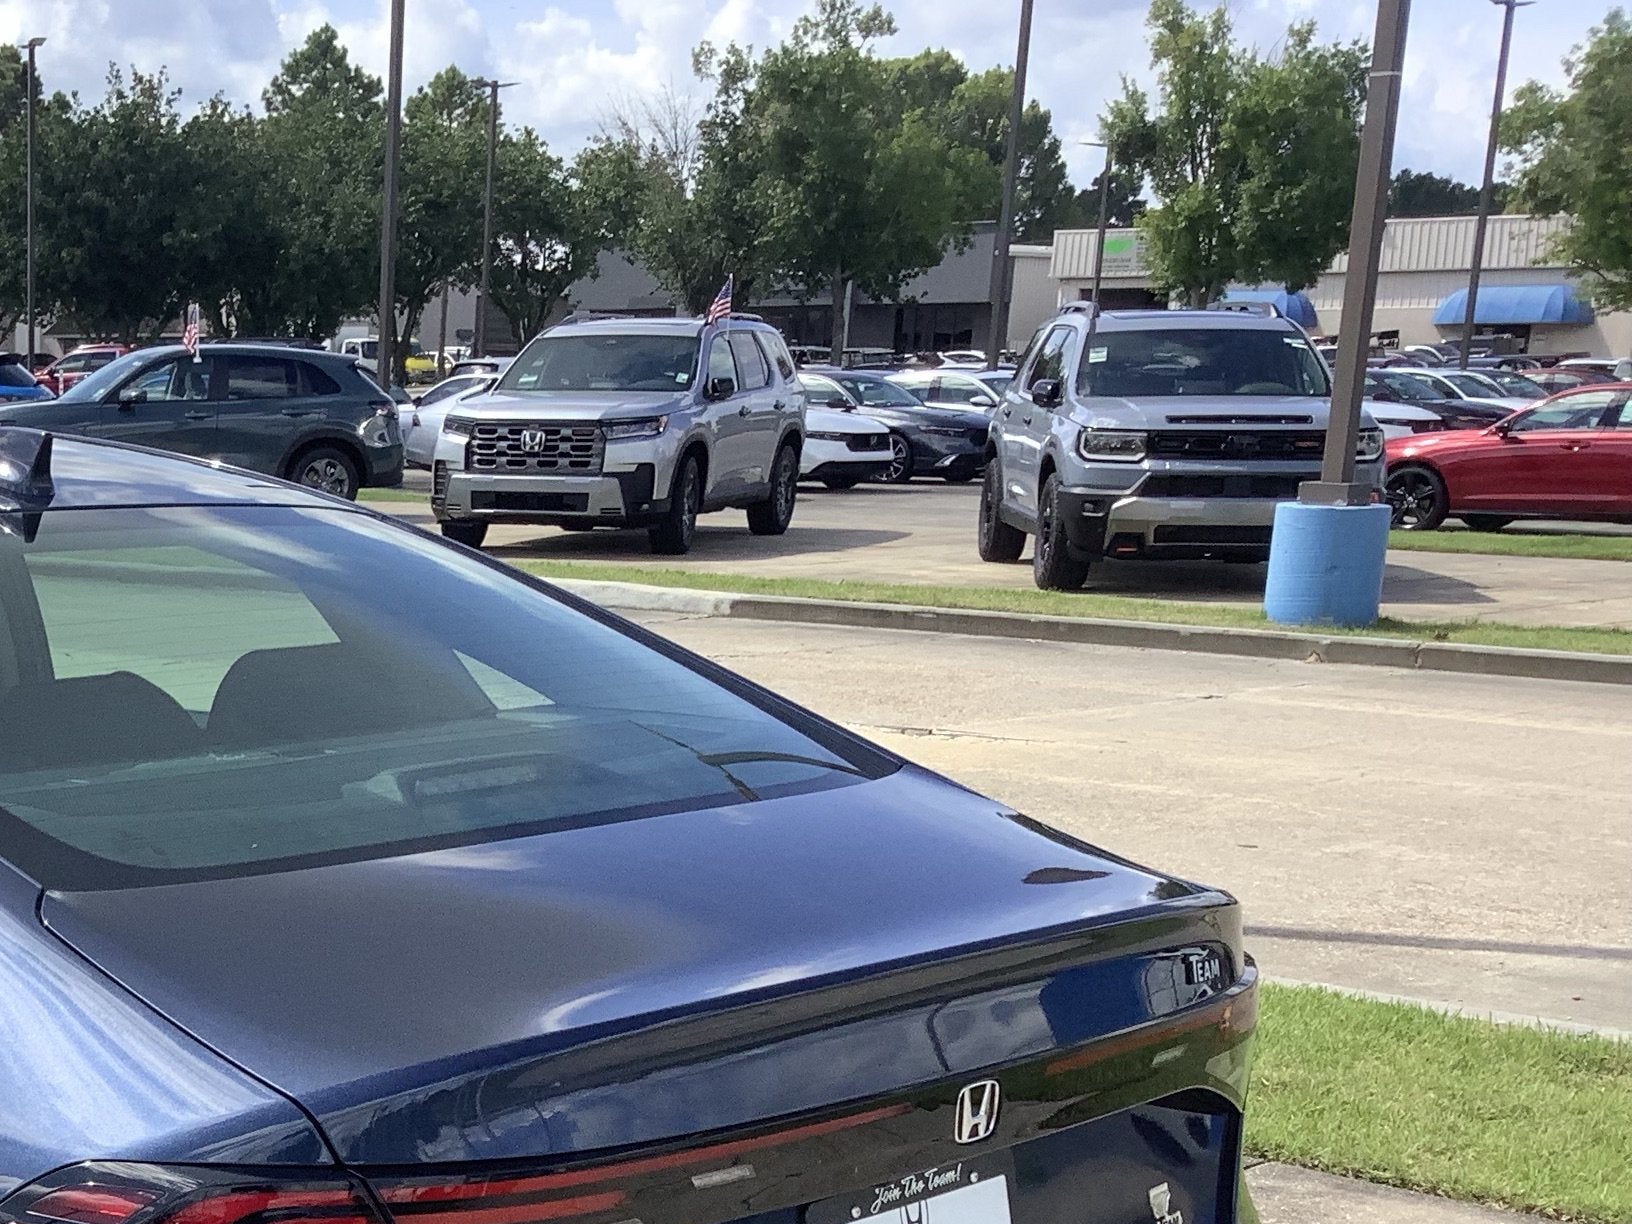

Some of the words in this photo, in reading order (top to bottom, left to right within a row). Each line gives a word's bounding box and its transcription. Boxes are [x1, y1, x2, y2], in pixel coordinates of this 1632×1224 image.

[1189, 955, 1220, 984] TEAM
[870, 1184, 902, 1214] Join
[924, 1163, 962, 1191] Team!
